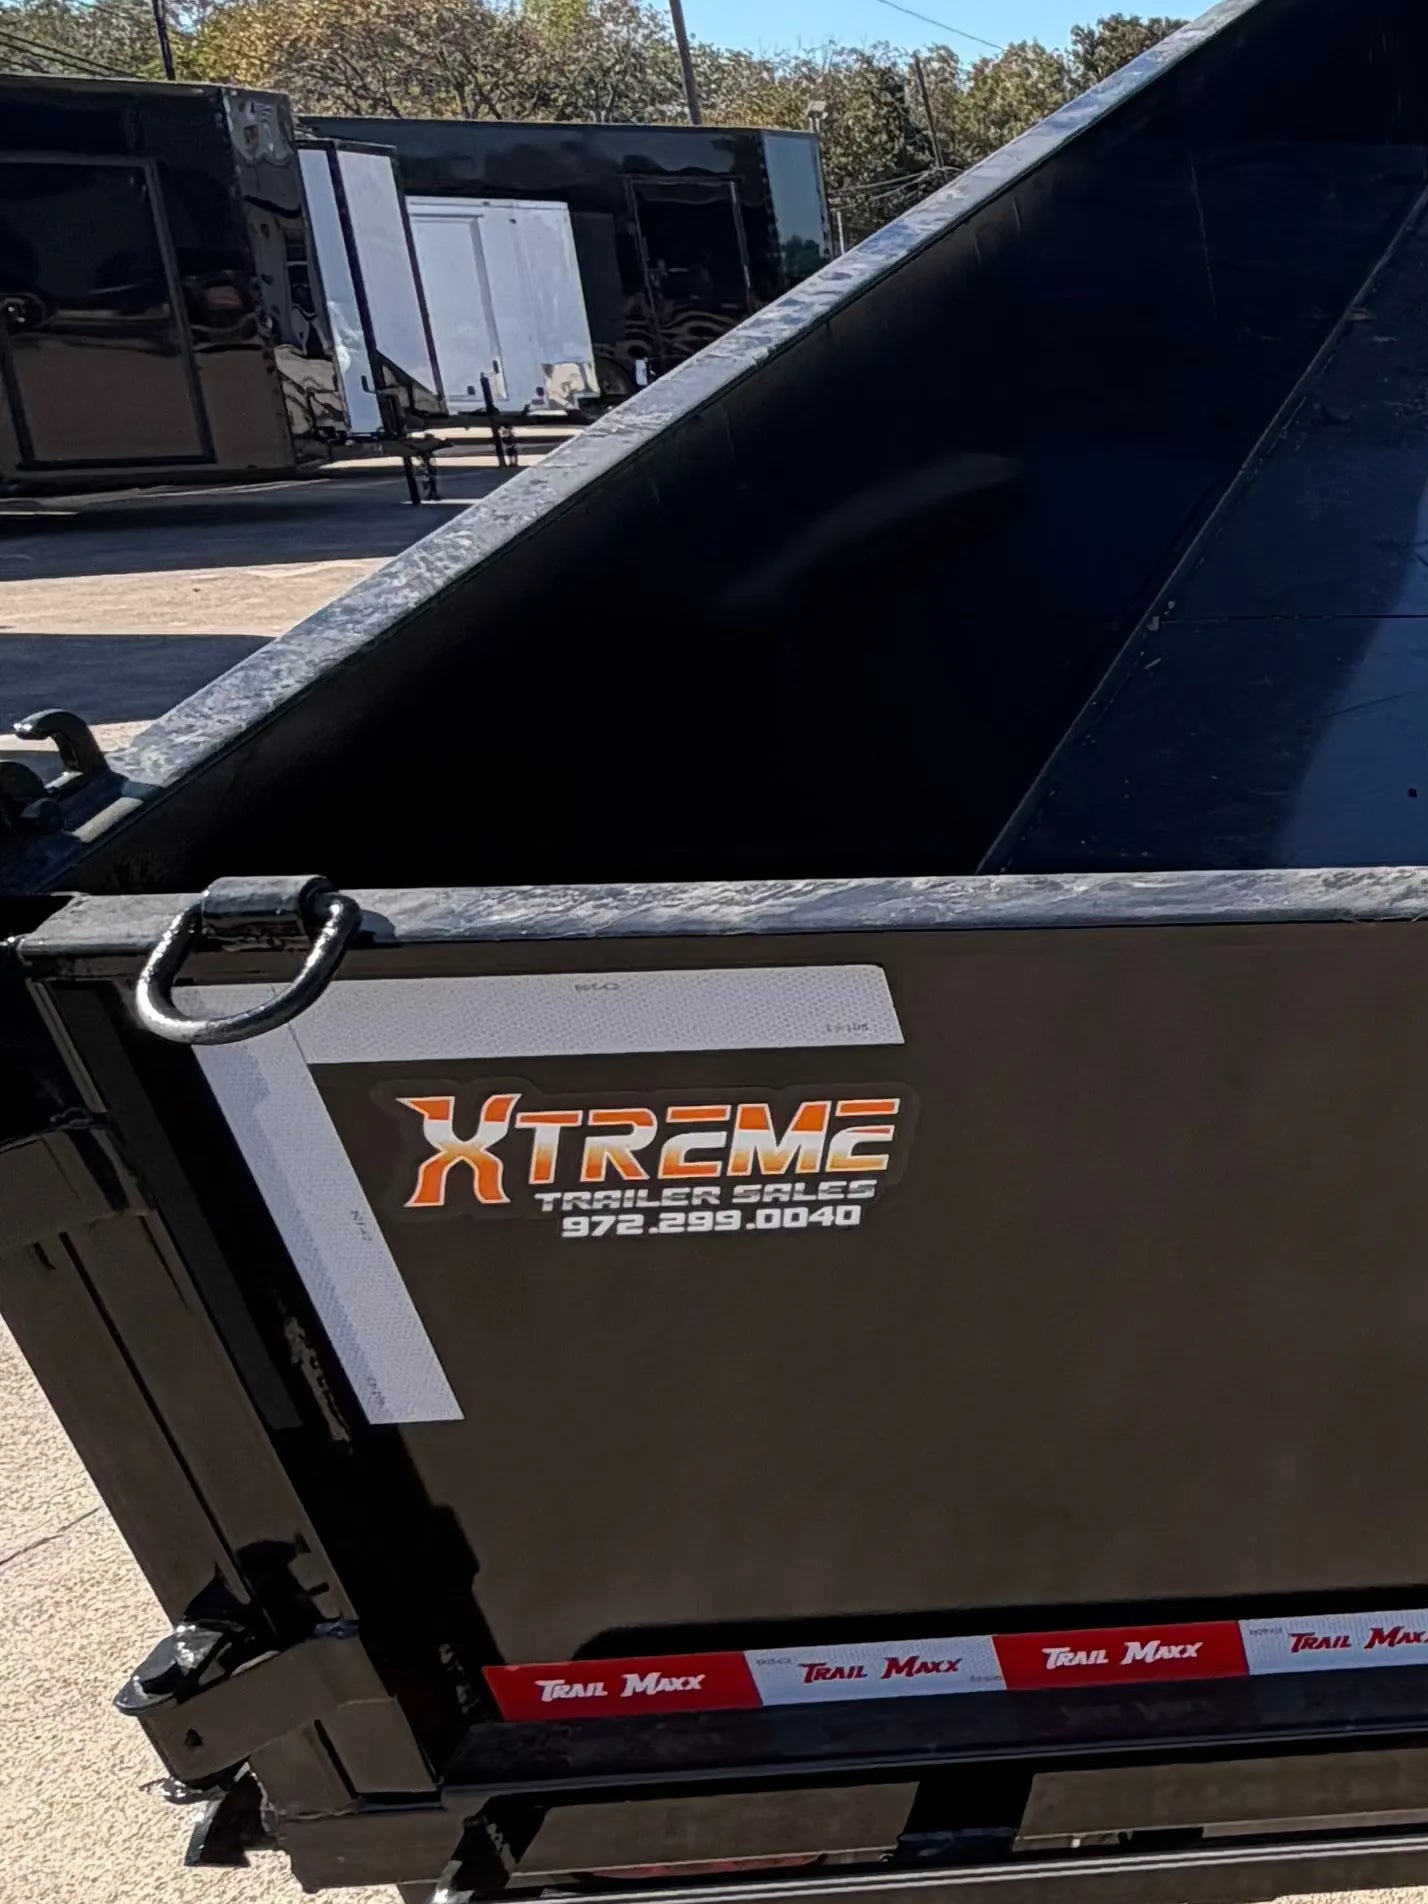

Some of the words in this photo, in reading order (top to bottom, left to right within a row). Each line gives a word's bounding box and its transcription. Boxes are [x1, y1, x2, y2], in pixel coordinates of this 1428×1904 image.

[396, 1092, 902, 1207] XTREME
[534, 1185, 721, 1211] TRAILER
[731, 1179, 878, 1204] SALES
[561, 1205, 863, 1239] 972.299.0040
[1042, 1647, 1110, 1669] TRAIL
[1121, 1641, 1203, 1664] MAXX
[1289, 1631, 1351, 1653] TRAIL
[800, 1663, 867, 1683] TRAIL
[882, 1656, 962, 1679] MAXX
[537, 1679, 607, 1702] TRAIL
[621, 1672, 705, 1697] MAXX
